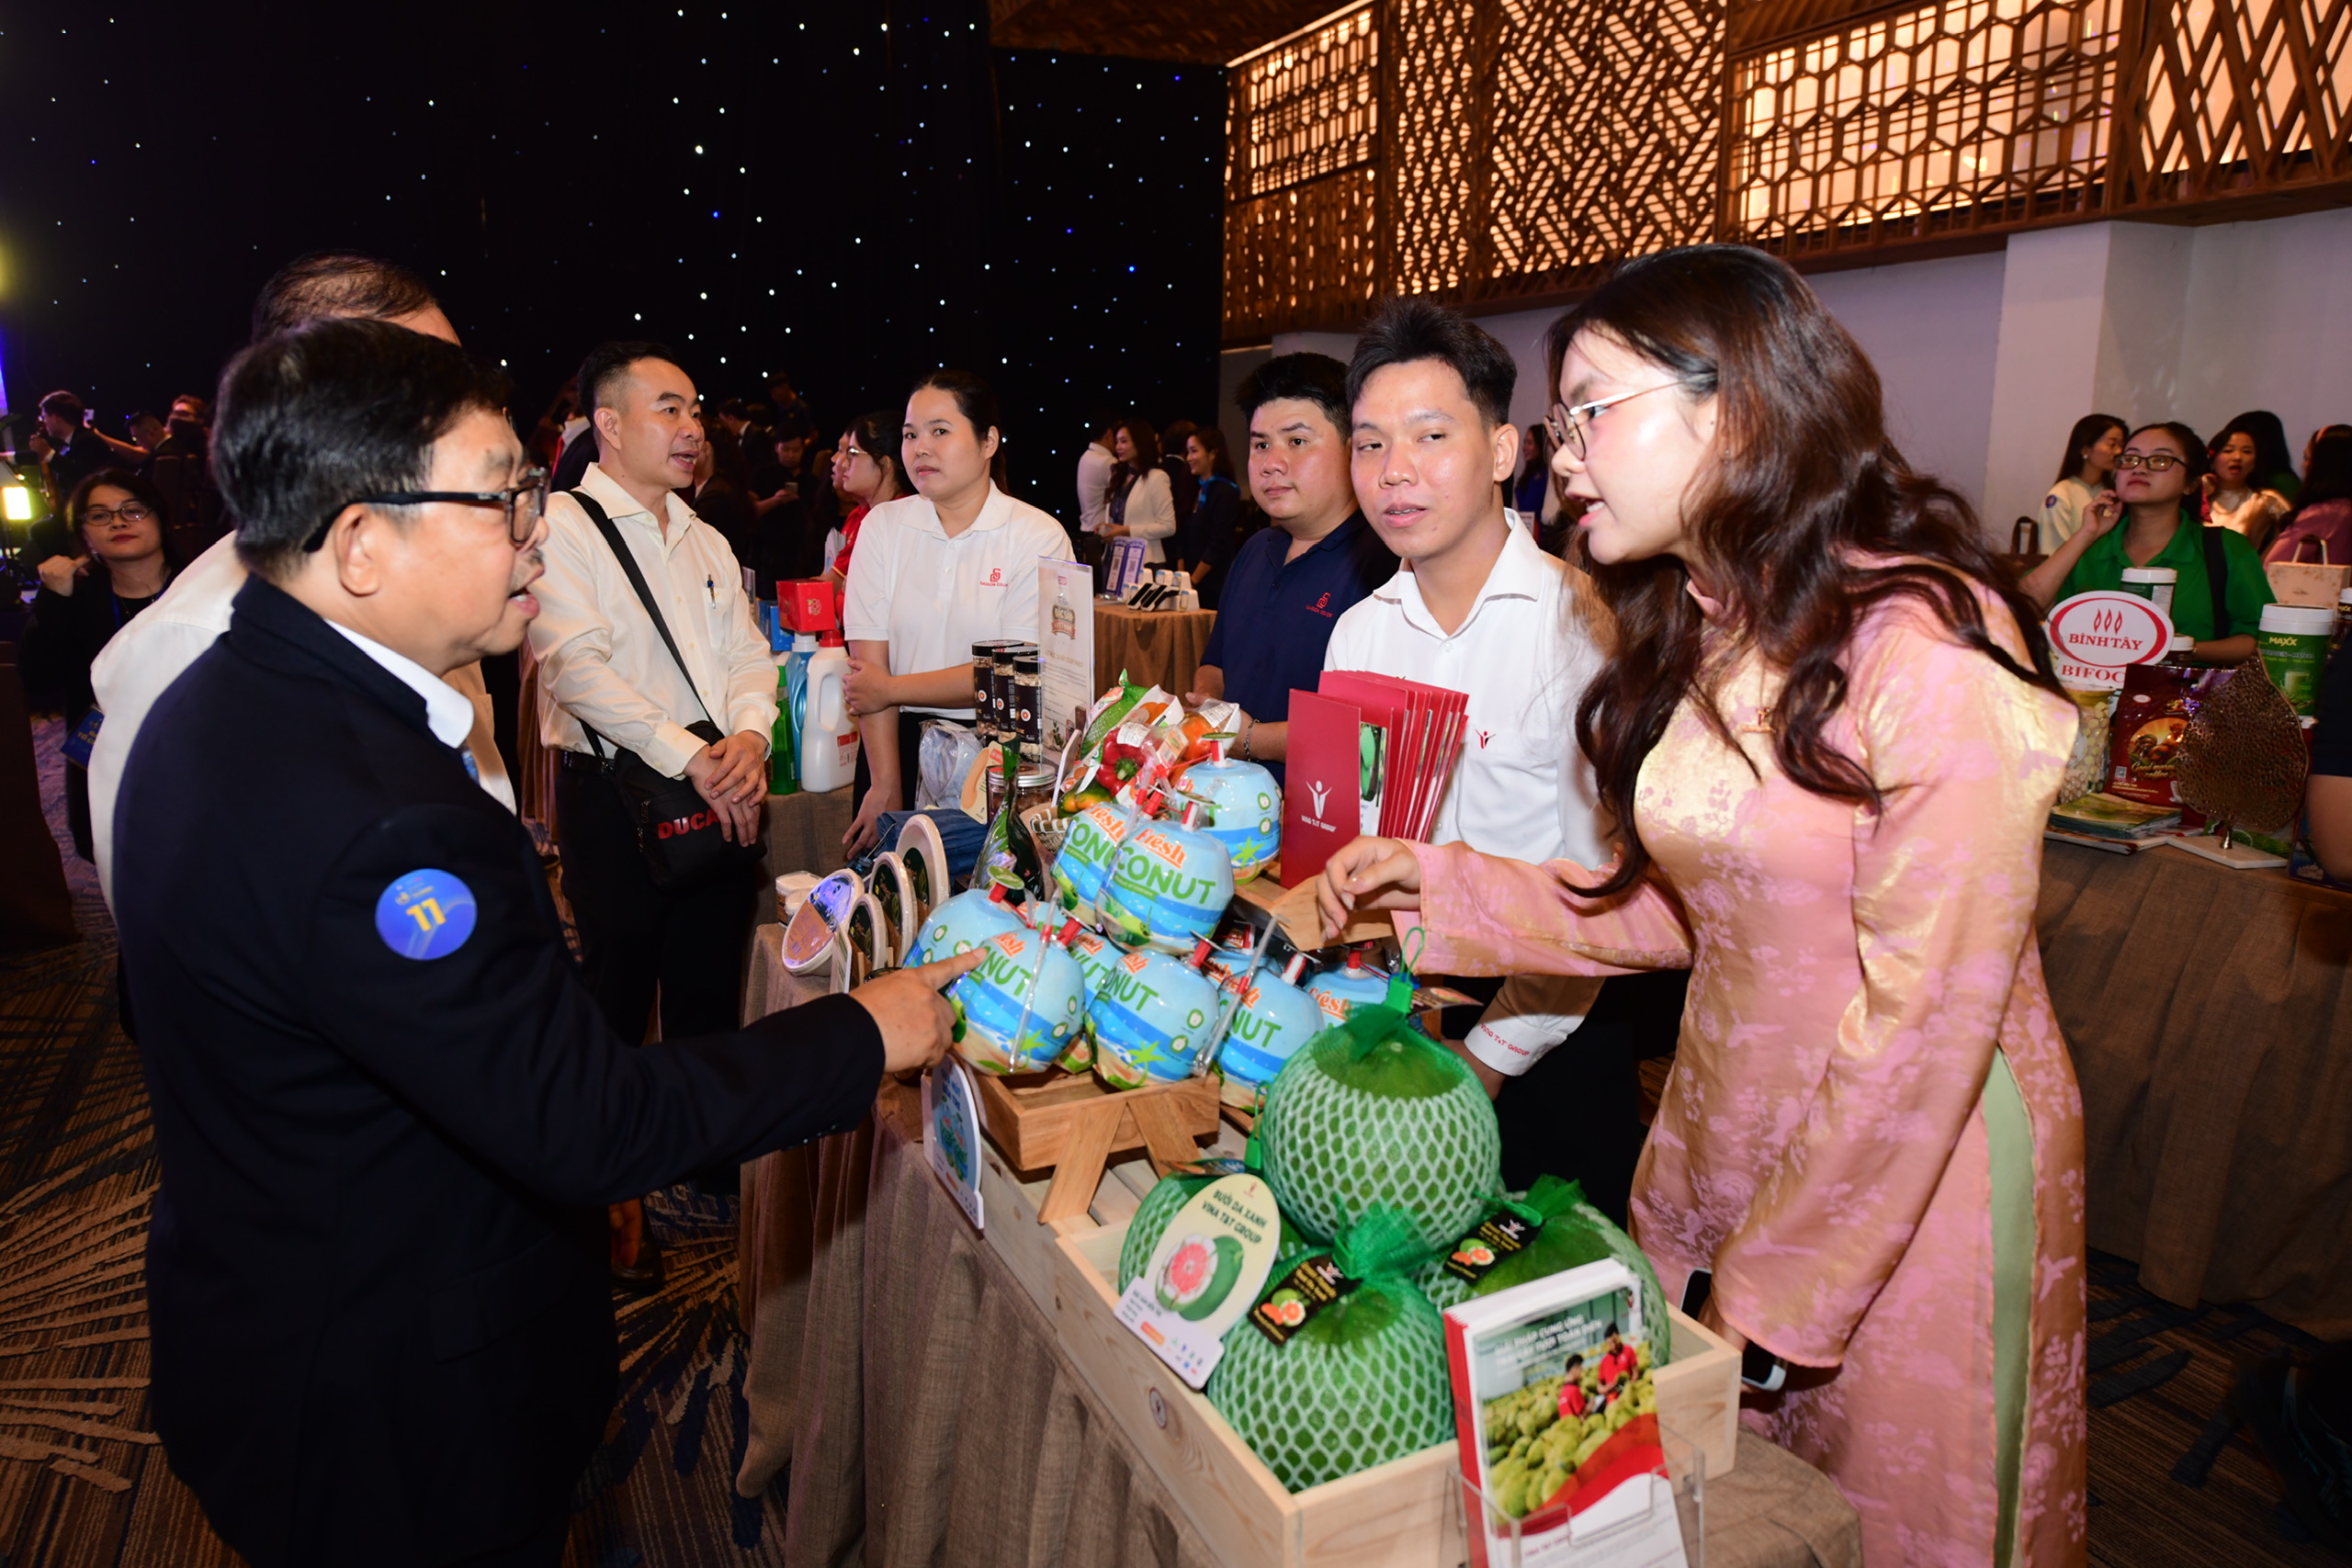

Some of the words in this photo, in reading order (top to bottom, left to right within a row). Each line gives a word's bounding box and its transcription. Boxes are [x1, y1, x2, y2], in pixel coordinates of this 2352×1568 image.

[406, 897, 447, 931] 11
[1508, 1043, 1531, 1056] GROUP
[1234, 1222, 1262, 1245] GROUP
